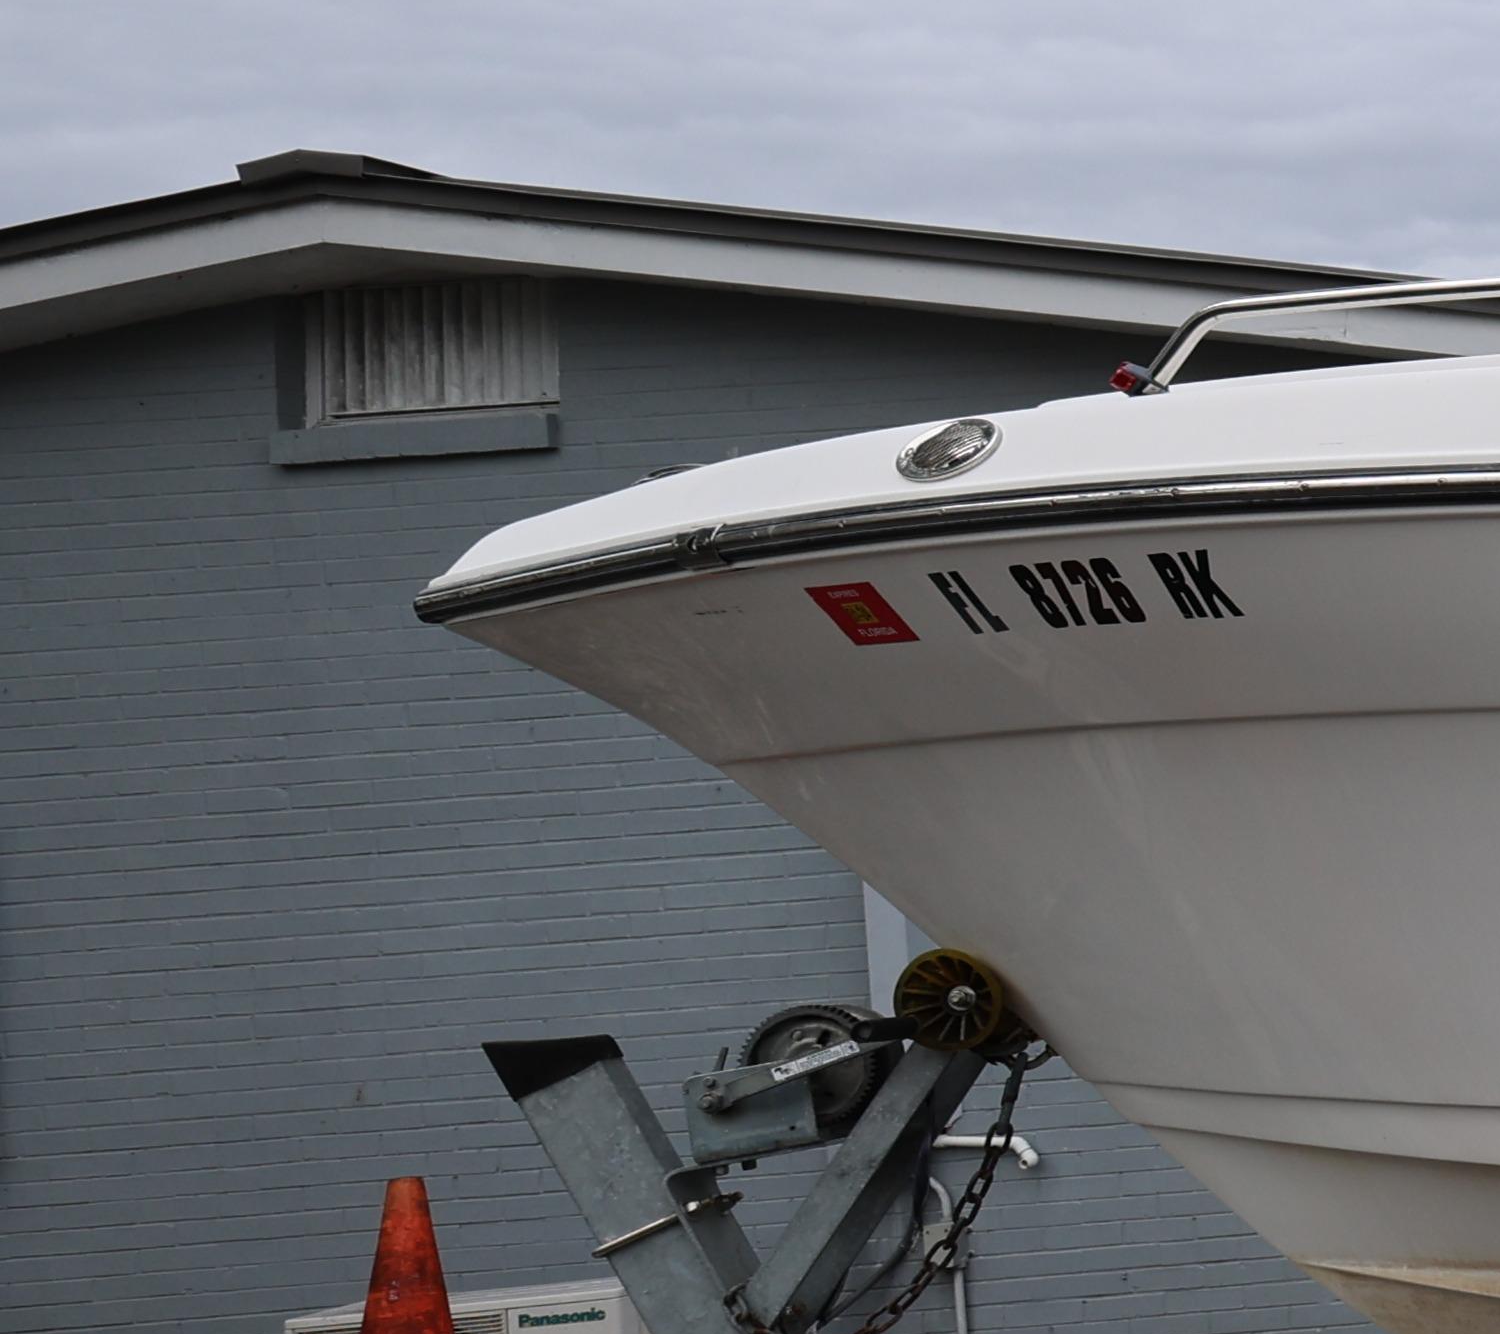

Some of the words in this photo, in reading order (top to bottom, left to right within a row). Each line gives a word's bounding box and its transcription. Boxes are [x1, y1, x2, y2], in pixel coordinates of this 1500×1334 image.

[928, 571, 1010, 634] FL
[1008, 558, 1146, 628] 8726
[1147, 549, 1245, 619] RK
[518, 1307, 606, 1328] Panasonic
